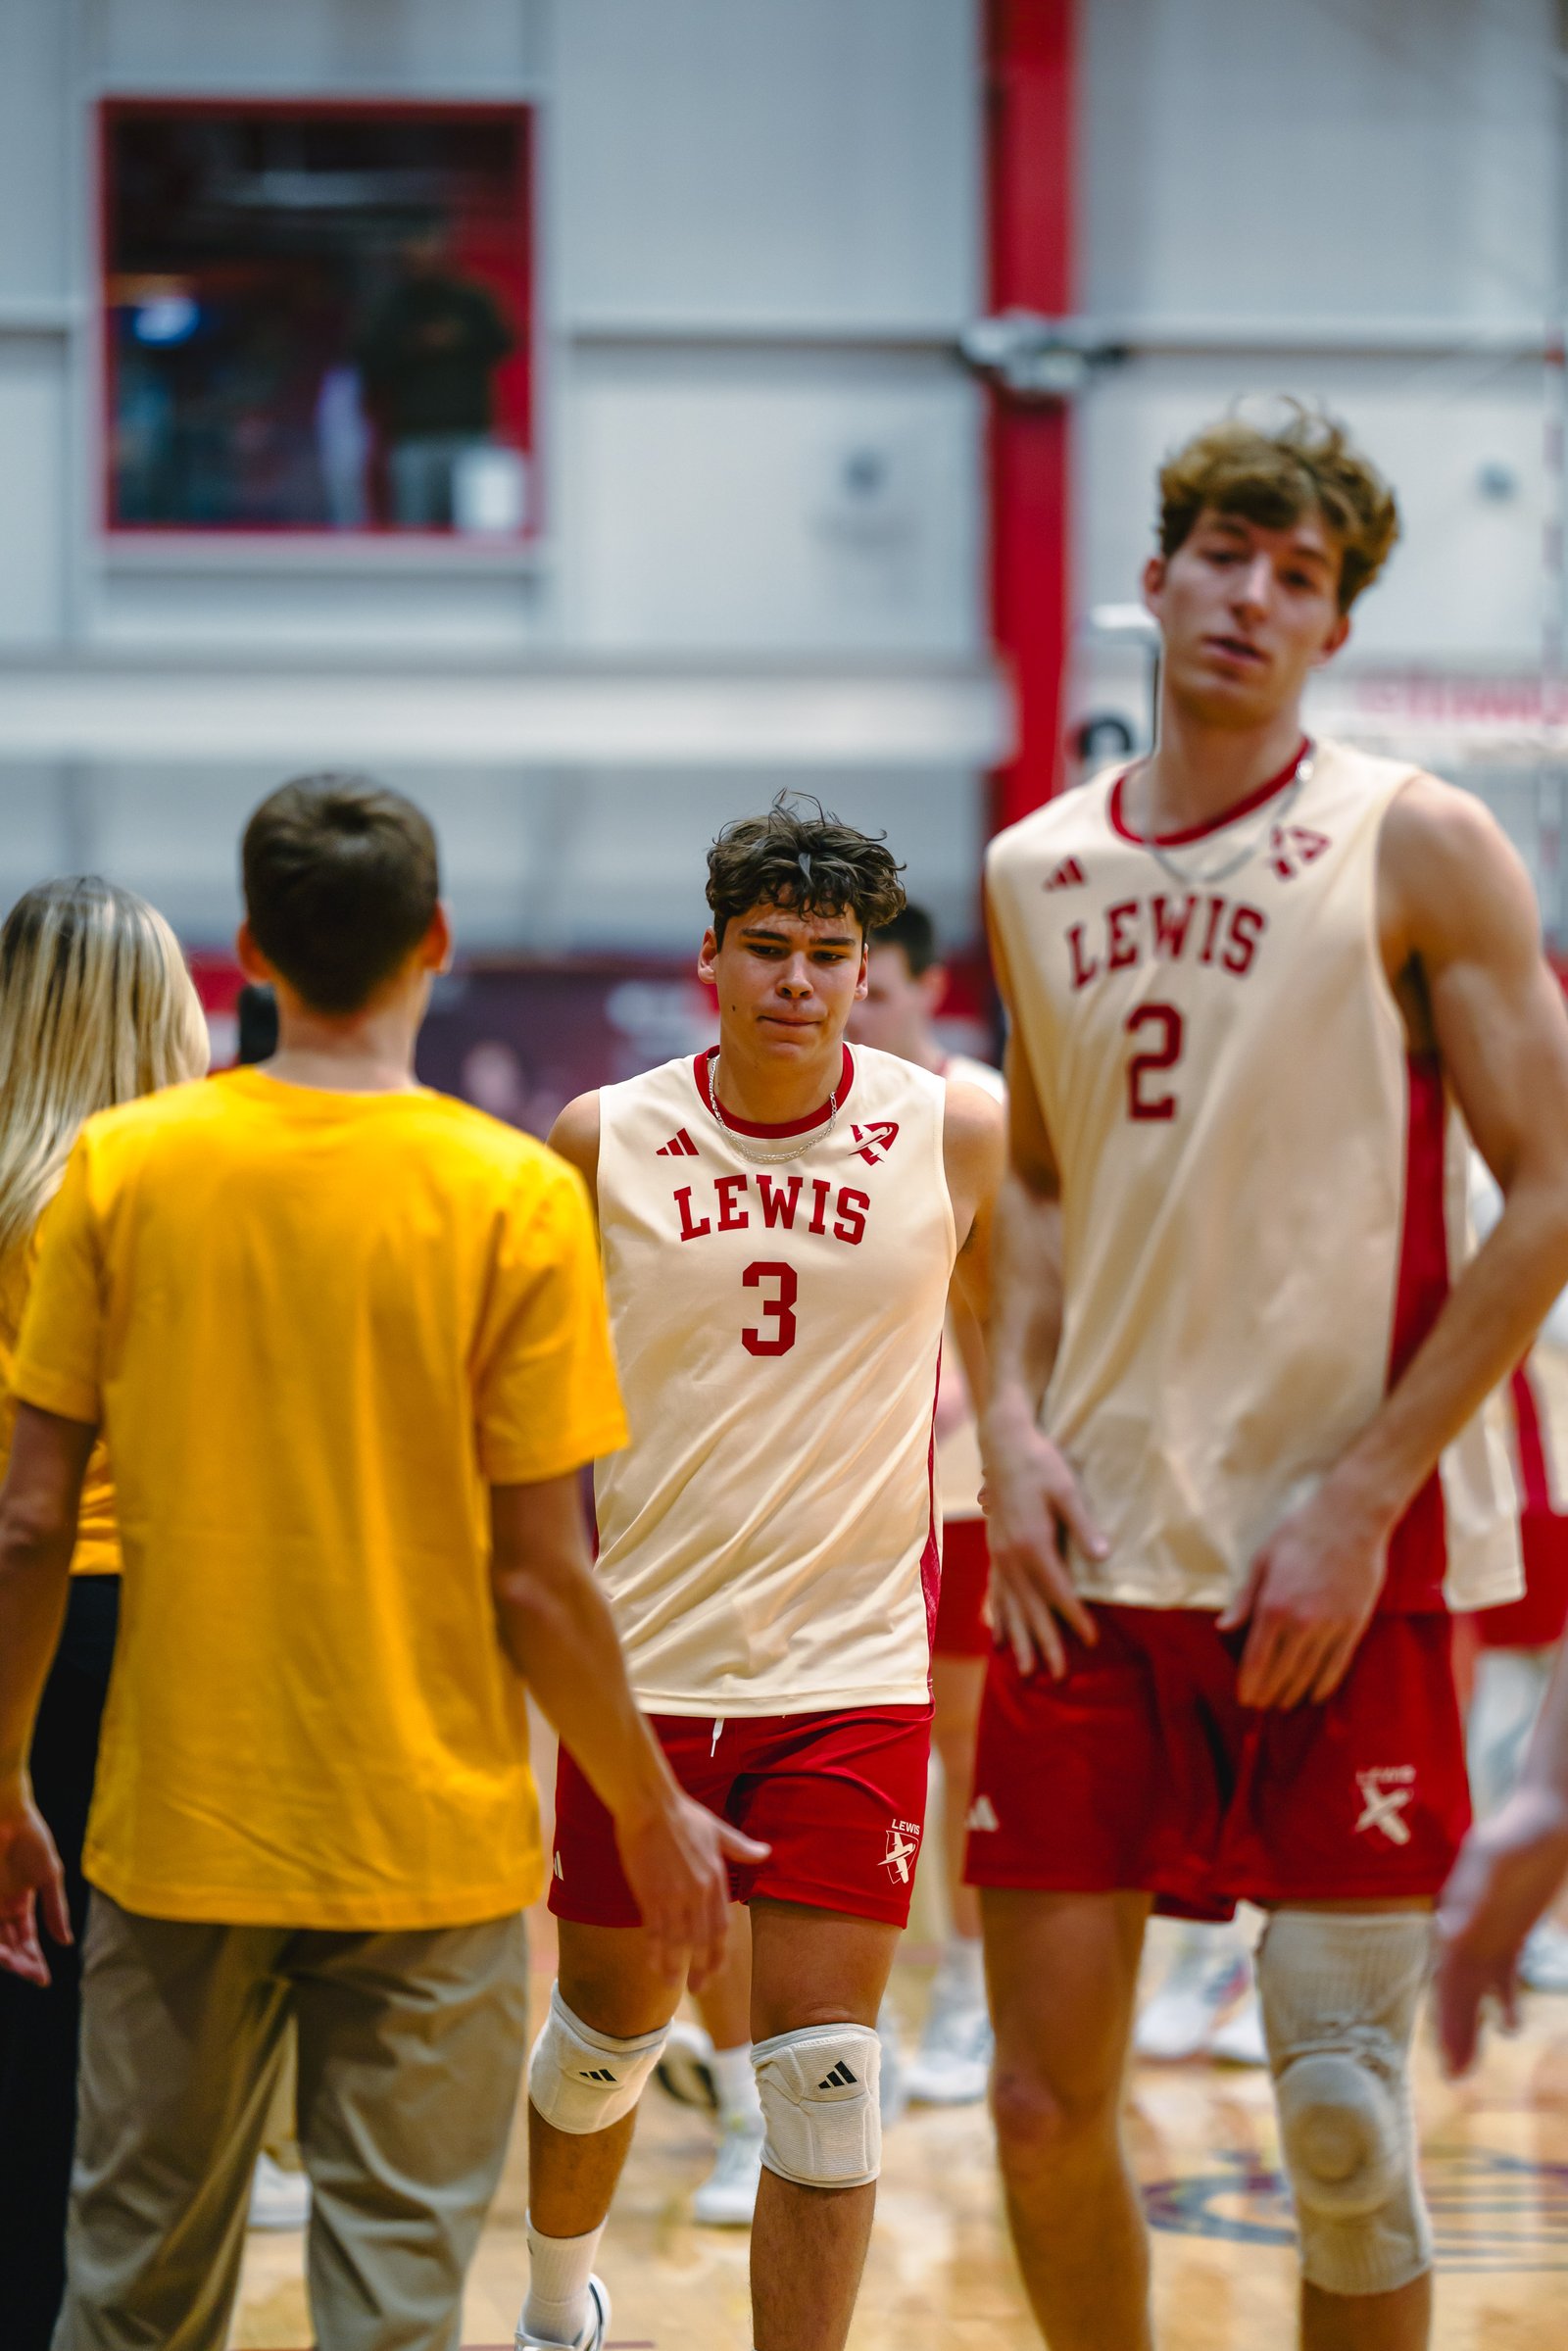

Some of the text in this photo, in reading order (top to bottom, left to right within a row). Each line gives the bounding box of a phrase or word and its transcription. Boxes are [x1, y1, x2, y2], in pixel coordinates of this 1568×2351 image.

[1066, 895, 1266, 990] LEWIS
[1125, 1004, 1184, 1121] 2
[672, 1174, 871, 1246] LEWIS
[741, 1261, 798, 1356] 3
[891, 1818, 921, 1836] LEWIS
